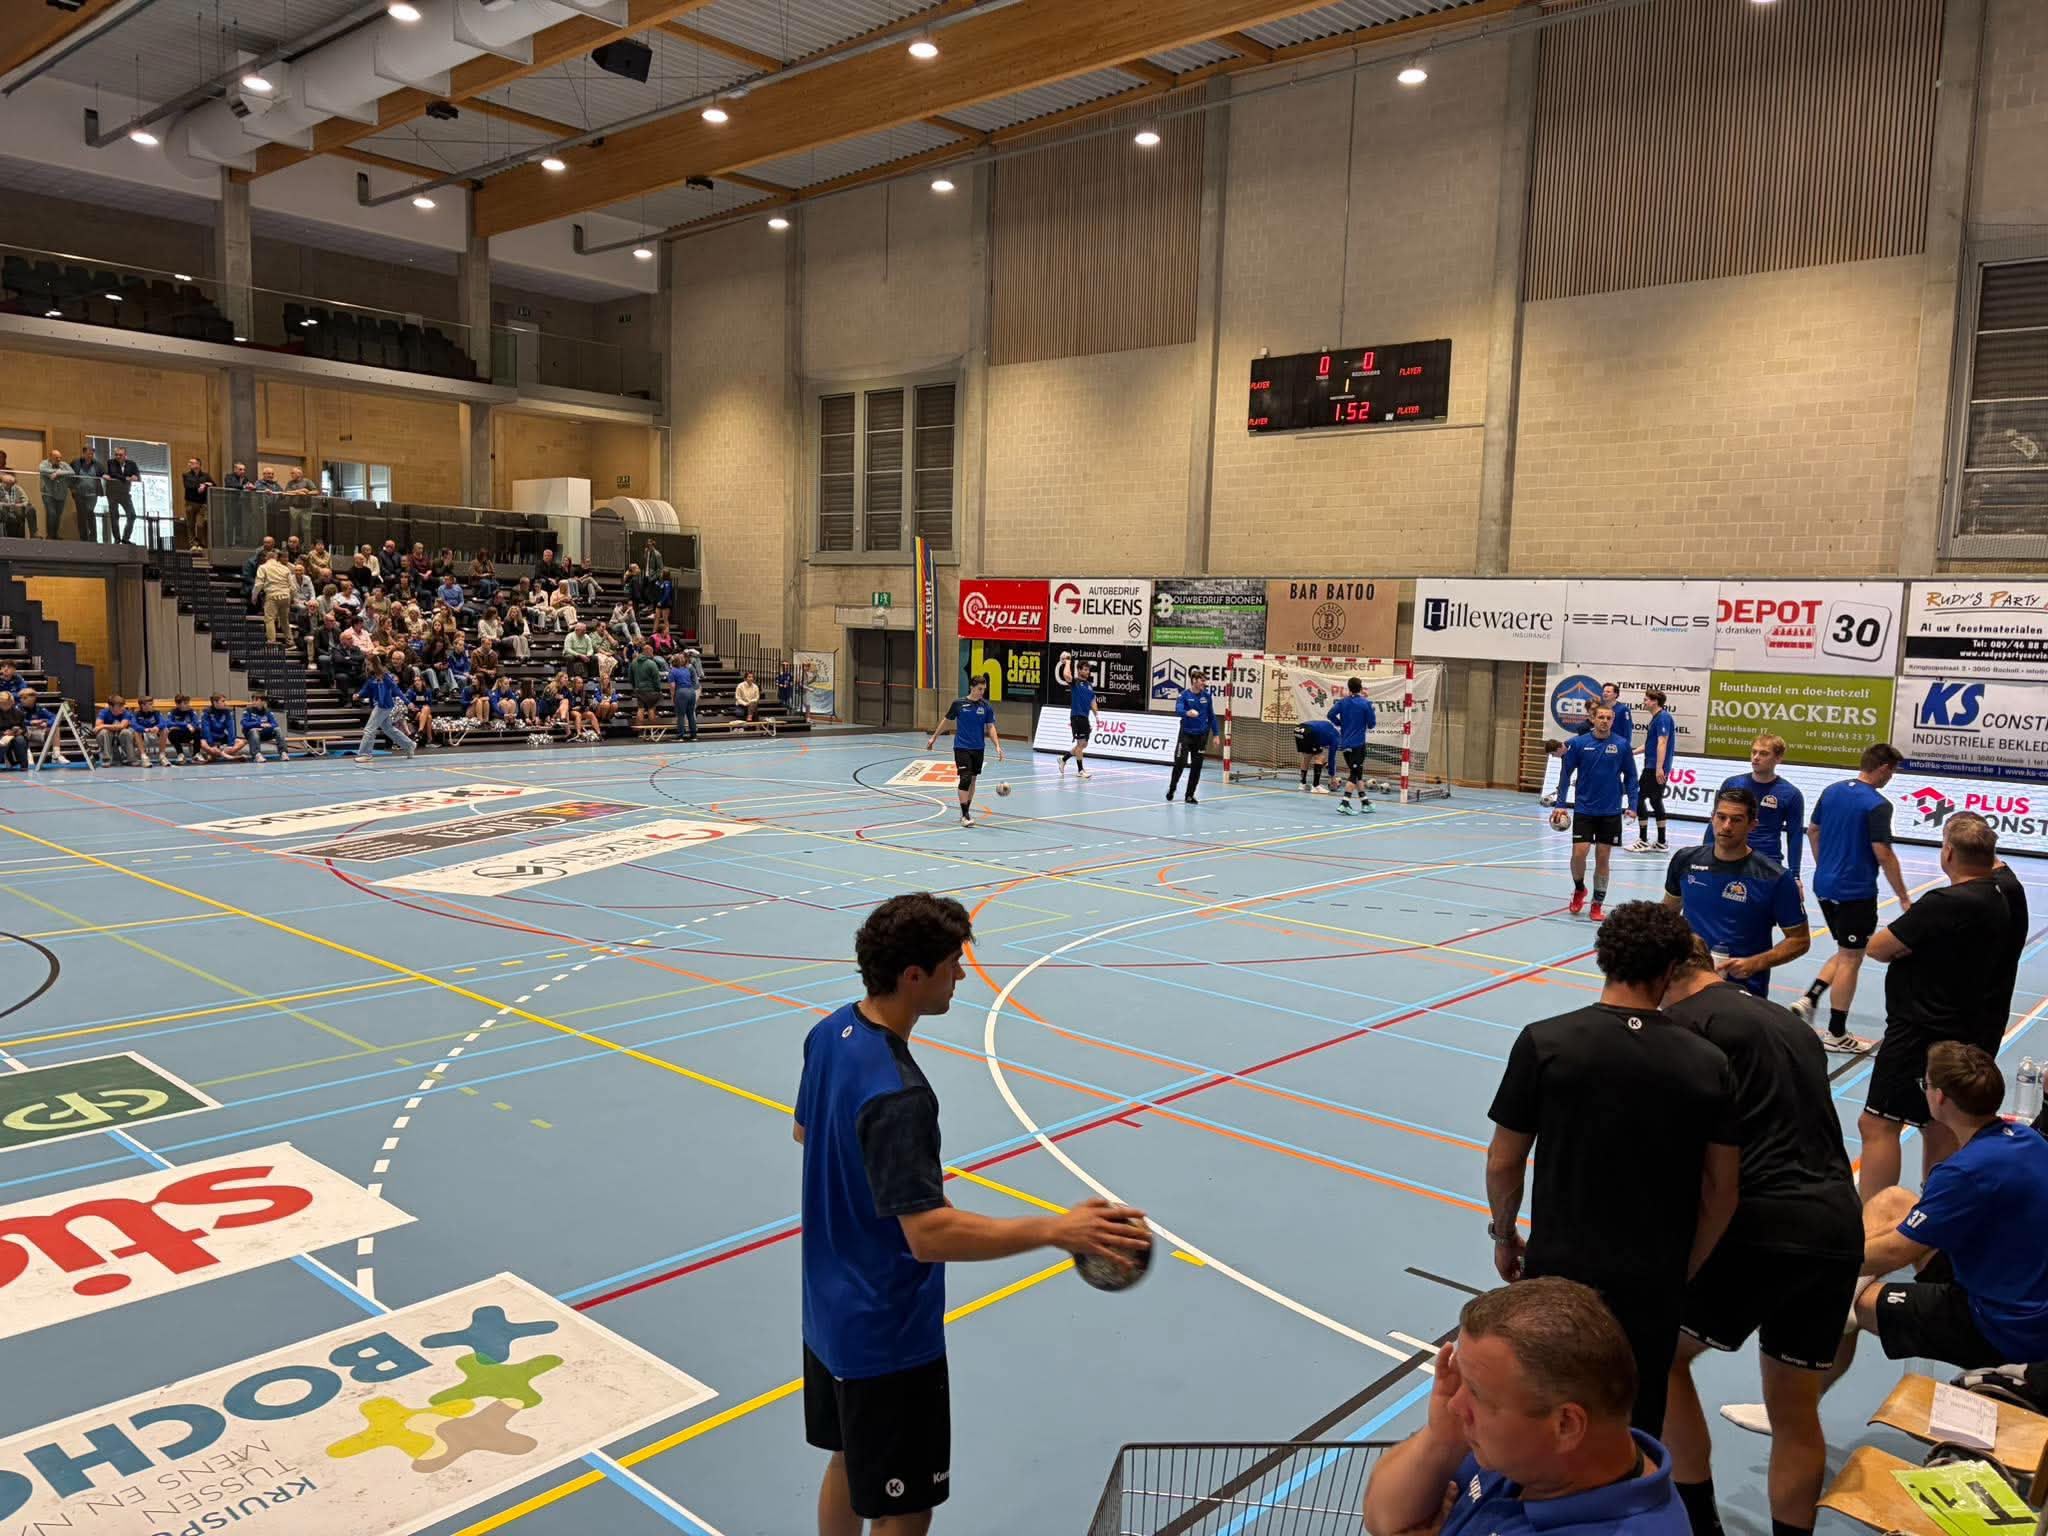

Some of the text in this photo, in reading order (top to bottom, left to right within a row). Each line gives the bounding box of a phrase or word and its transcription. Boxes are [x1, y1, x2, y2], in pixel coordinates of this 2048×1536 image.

[1319, 352, 1375, 374] 0 0
[1290, 583, 1375, 600] BAR BATOO
[1226, 596, 1262, 605] BOONEN
[976, 611, 1041, 626] THOLEN
[1425, 599, 1552, 631] Hillewaere
[1054, 624, 1072, 634] Bree
[1080, 624, 1115, 635] Lommel
[1512, 632, 1551, 640] INSURANCE
[1725, 626, 1761, 635] dranken
[1832, 614, 1881, 647] 30
[1920, 623, 1931, 632] Al
[1956, 623, 2043, 635] feestmaterialen
[1080, 650, 1096, 658] Laura
[1103, 650, 1121, 659] Glenn
[1296, 643, 1321, 652] BISTRO
[1328, 644, 1360, 653] BOCHOLT
[1008, 649, 1040, 669] hen
[1110, 663, 1133, 672] Frituur
[1007, 668, 1040, 684] drix
[1110, 672, 1134, 681] Snacks
[1109, 681, 1140, 691] Broodjes
[1720, 682, 1870, 699] Houthandel en doe-het-zelf
[1710, 699, 1877, 726] ROOYACKERS
[1920, 682, 1985, 727] KS
[1096, 720, 1126, 734] PLUS
[1094, 733, 1169, 750] CONSTRUCT
[1912, 733, 1995, 749] INDUSTRIELE
[1965, 794, 2030, 814] PLUS
[1907, 1209, 1928, 1228] 37
[157, 1440, 270, 1491] MENS
[142, 1460, 297, 1523] TUSSEN
[87, 1486, 146, 1515] EN
